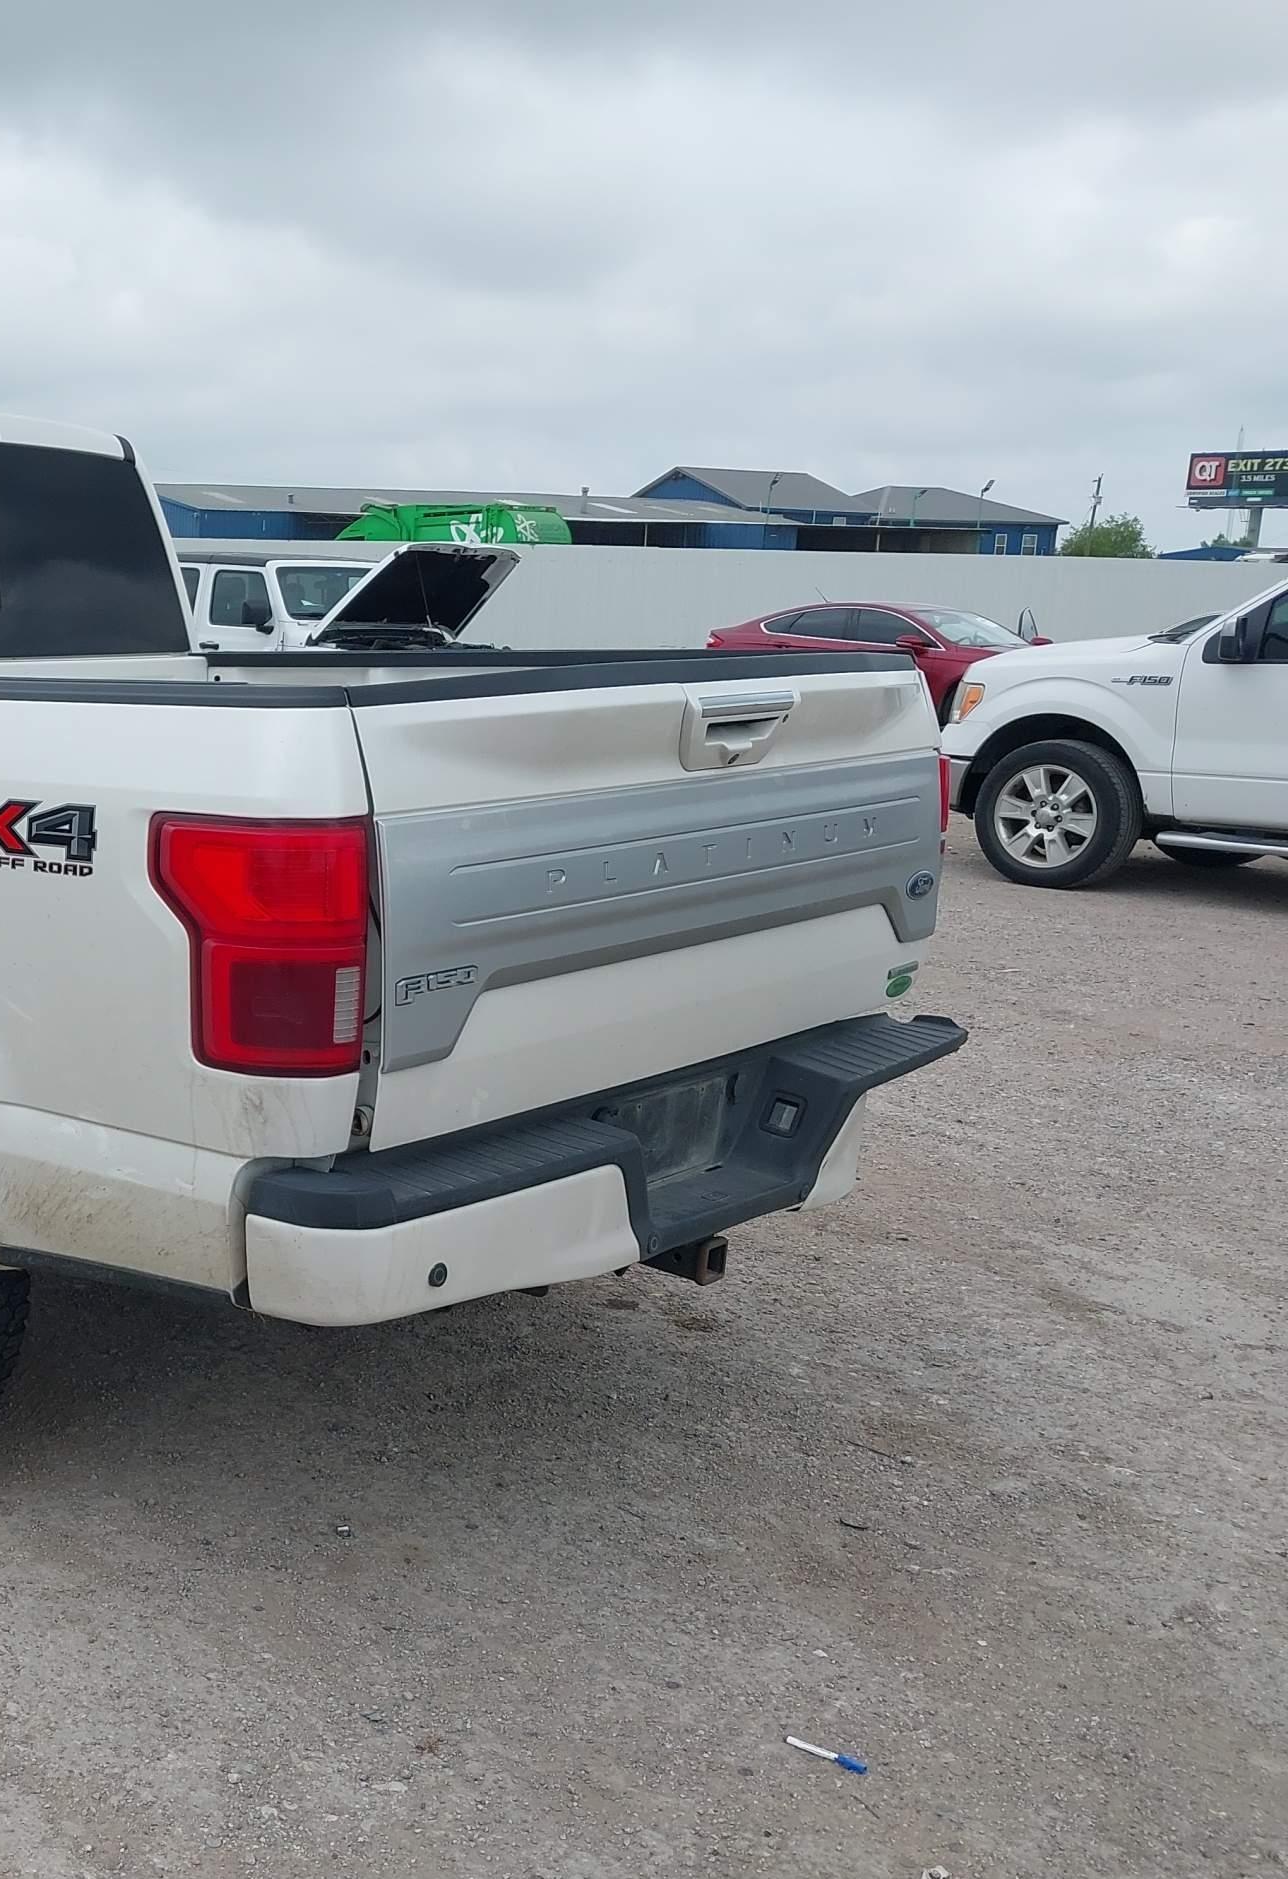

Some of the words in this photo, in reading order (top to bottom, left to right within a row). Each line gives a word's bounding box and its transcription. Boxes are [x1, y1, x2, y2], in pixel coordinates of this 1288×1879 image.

[1194, 461, 1220, 480] QT
[1227, 459, 1261, 471] EXIT
[1253, 474, 1276, 482] MILES
[546, 816, 878, 893] PLATINUM
[33, 860, 93, 877] ROAD
